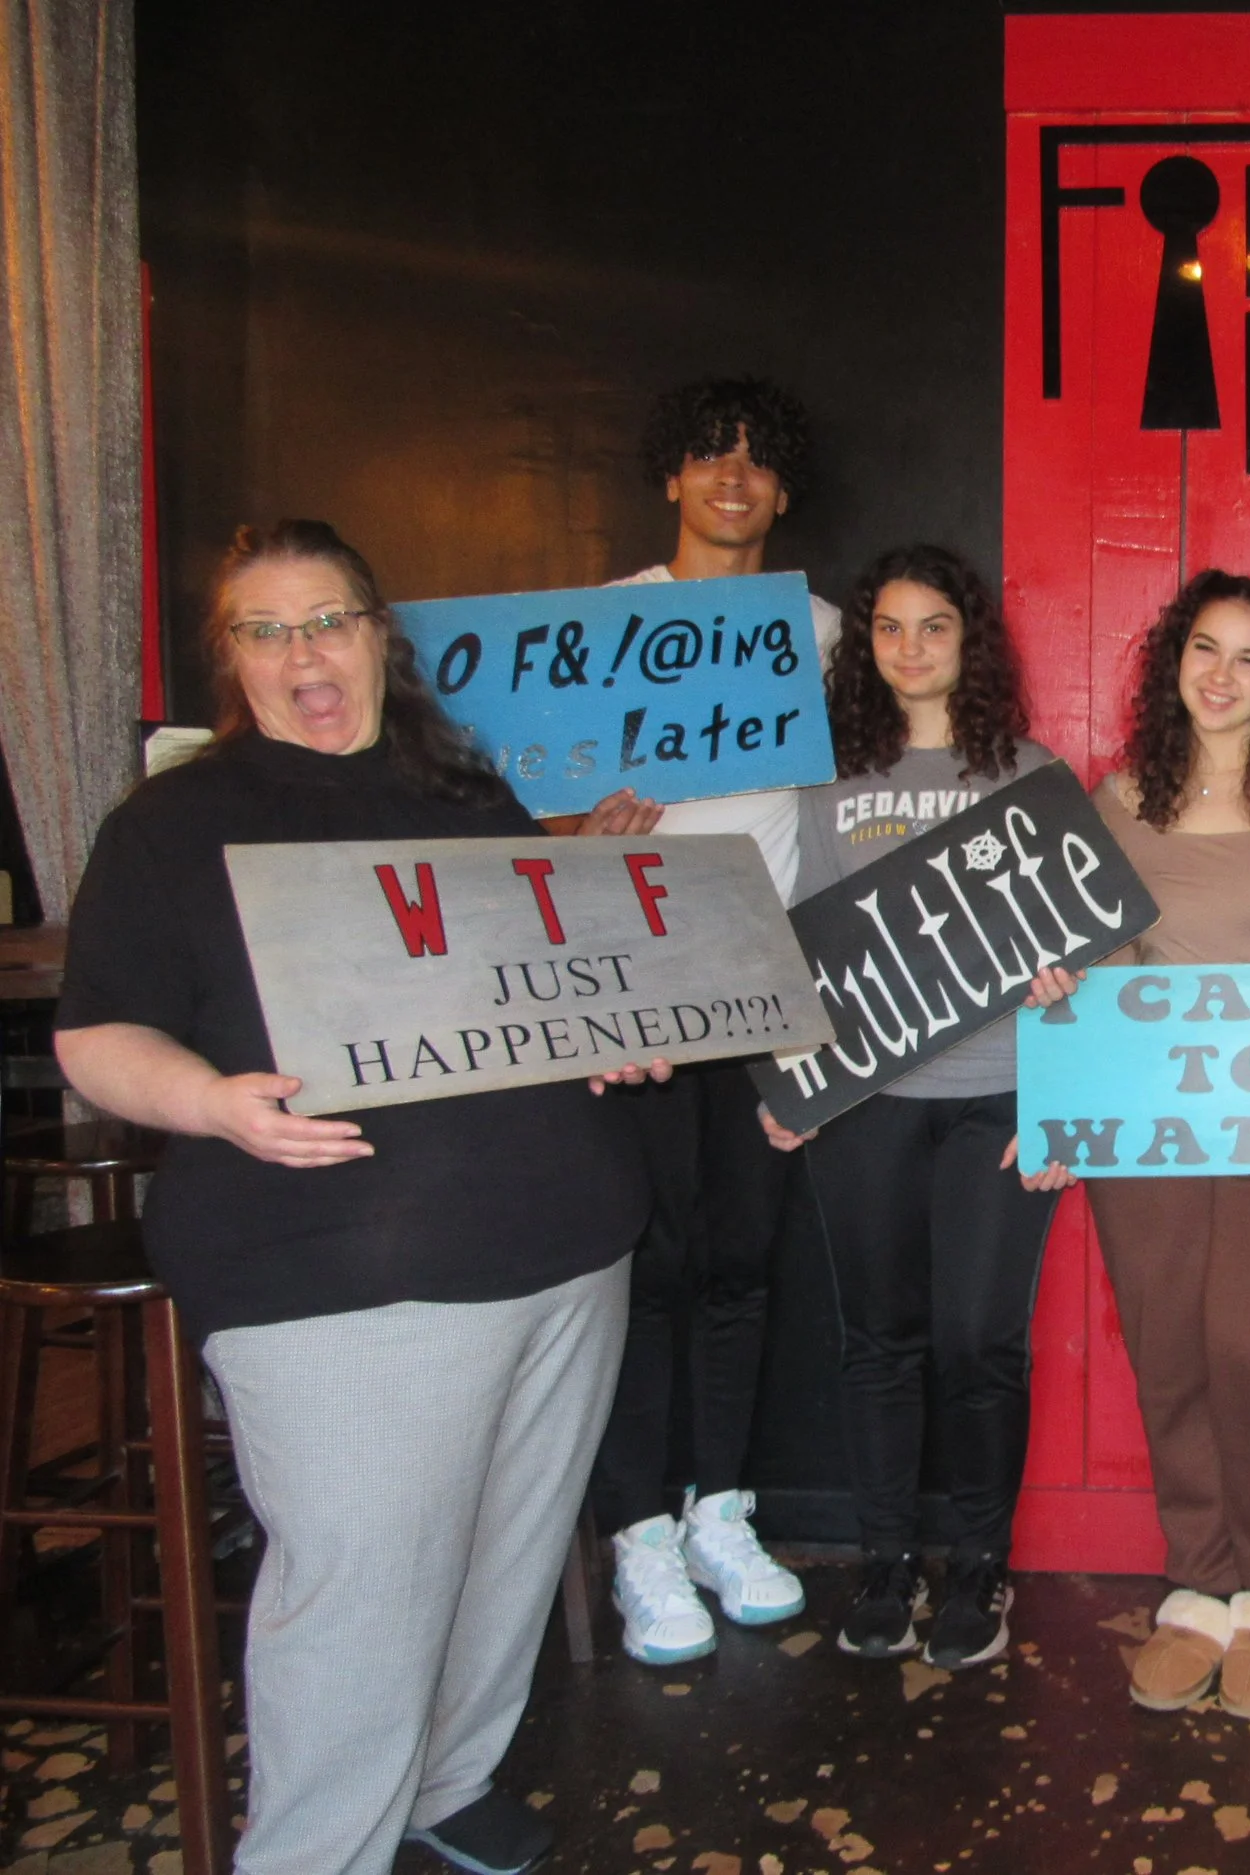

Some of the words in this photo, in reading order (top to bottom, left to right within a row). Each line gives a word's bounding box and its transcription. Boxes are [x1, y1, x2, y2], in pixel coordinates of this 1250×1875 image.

[619, 703, 799, 773] Later
[836, 789, 981, 834] CEDARVI
[850, 822, 907, 845] YELLOW
[492, 954, 633, 1005] JUST
[342, 994, 789, 1087] HAPPENED?!?!
